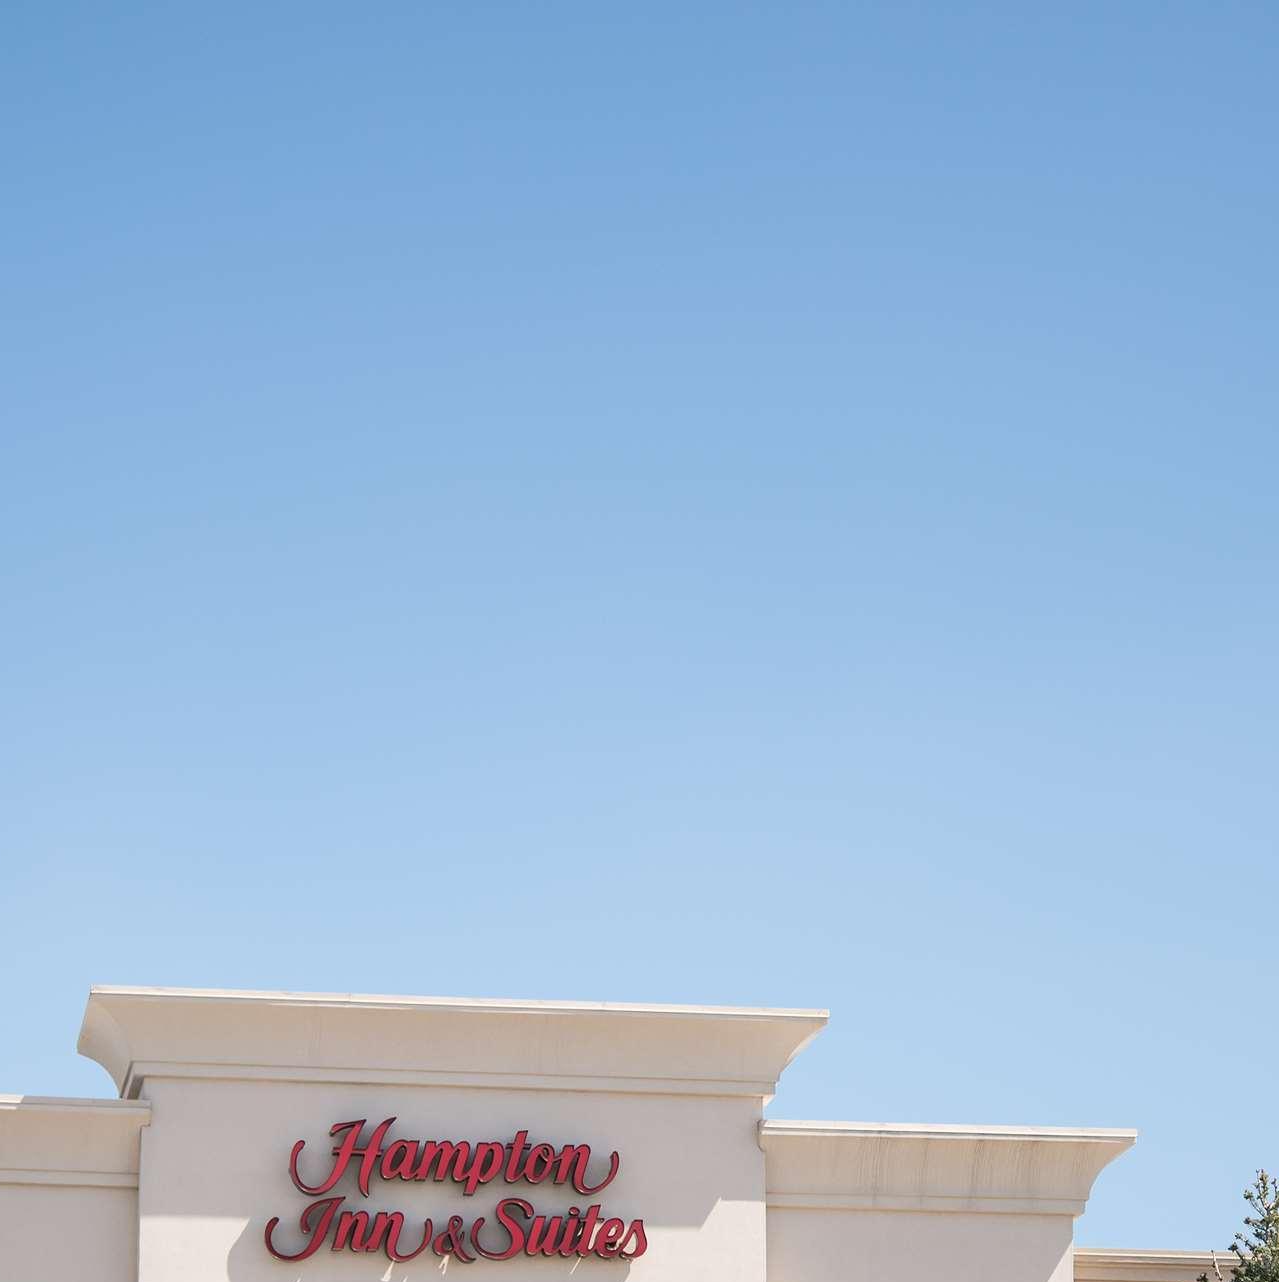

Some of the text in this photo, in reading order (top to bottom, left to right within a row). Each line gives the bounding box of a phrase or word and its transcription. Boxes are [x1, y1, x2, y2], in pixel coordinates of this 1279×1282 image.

[289, 1117, 620, 1197] Hampton
[264, 1196, 649, 1264] Inn & Suites
